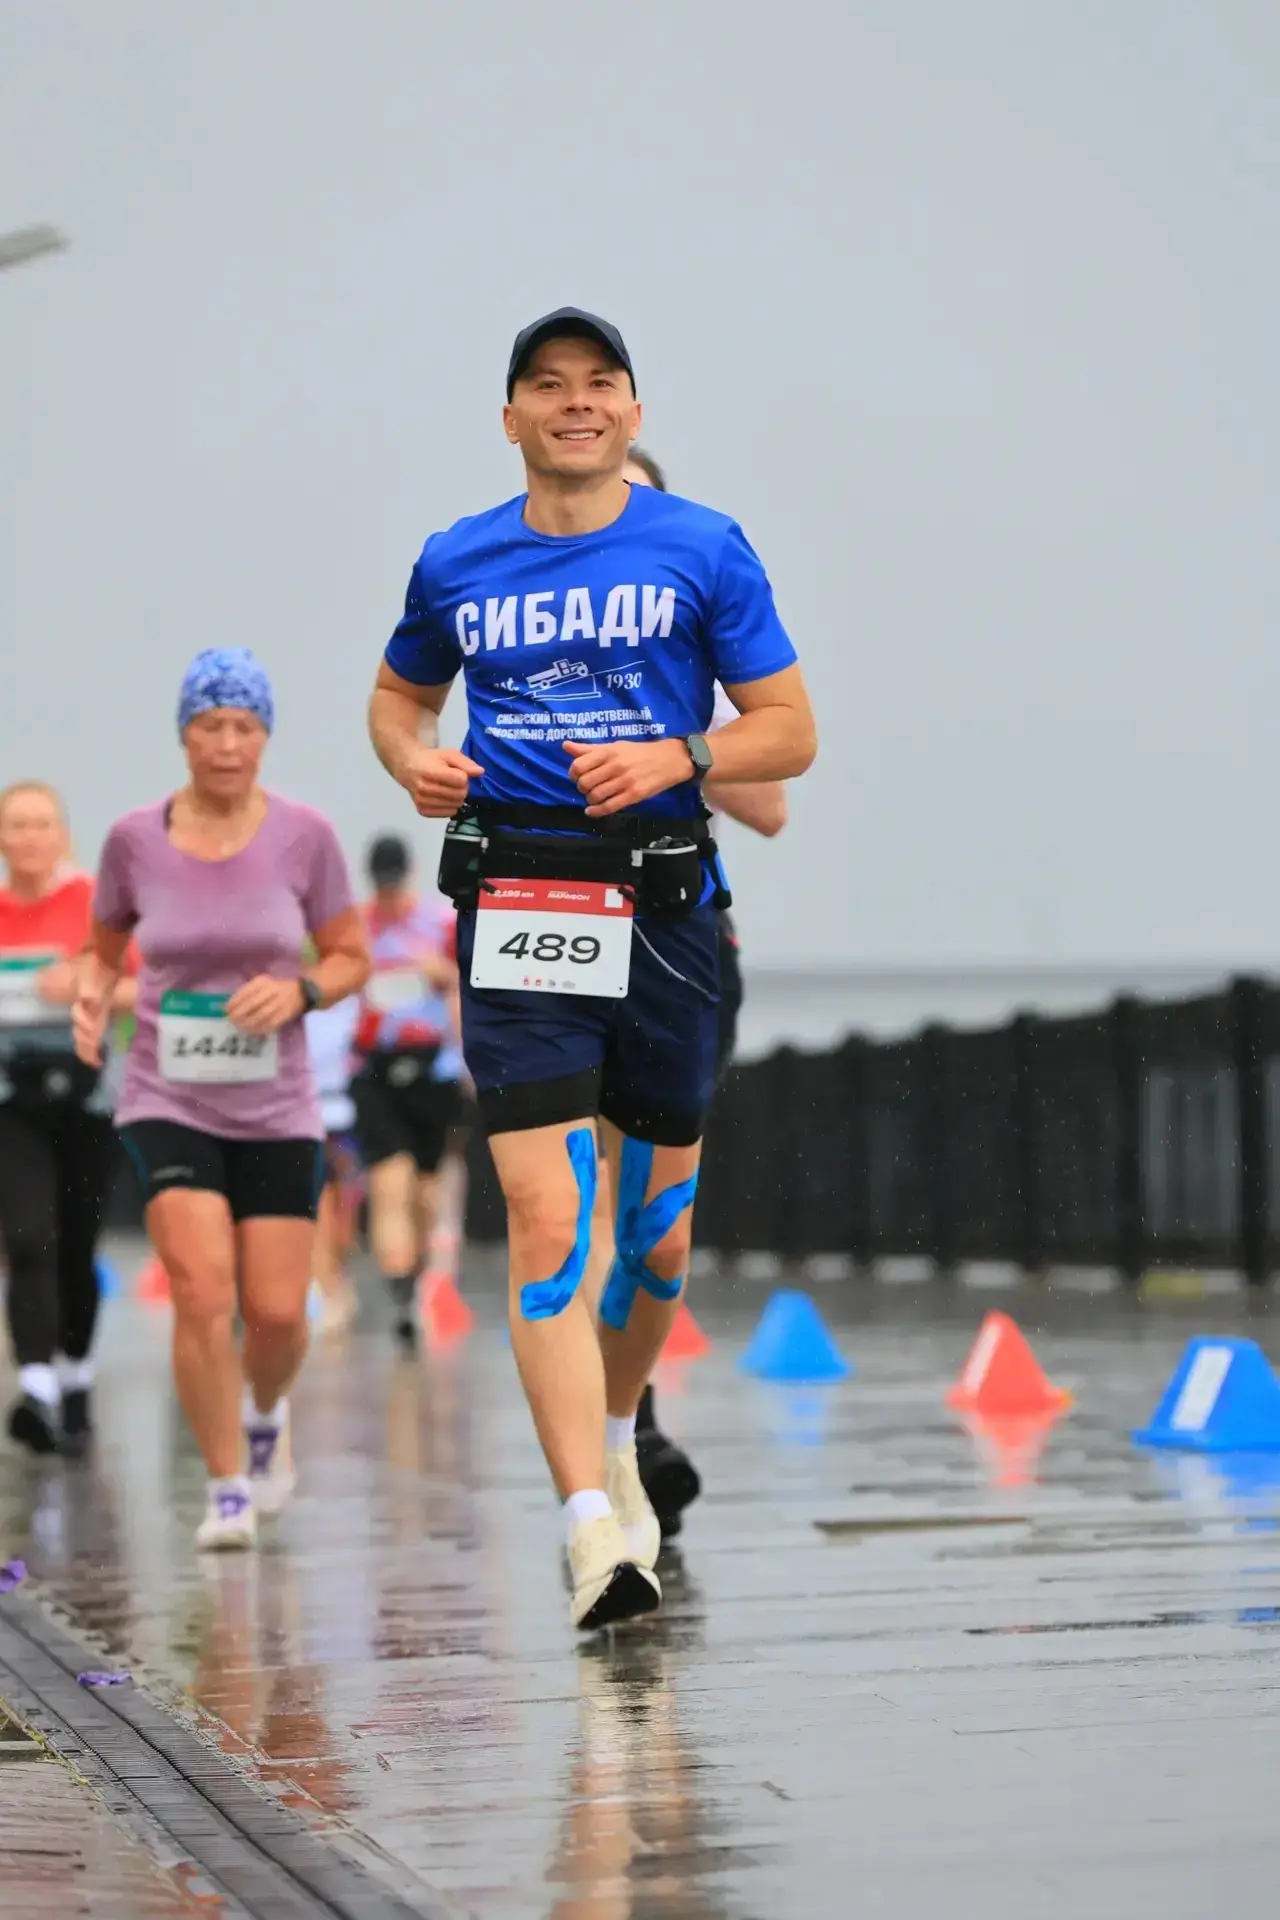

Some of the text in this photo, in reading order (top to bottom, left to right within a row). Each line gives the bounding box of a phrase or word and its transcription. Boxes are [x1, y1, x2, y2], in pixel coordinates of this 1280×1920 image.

[455, 584, 676, 656] СИБАДИ
[605, 671, 643, 690] 1930
[496, 705, 652, 725] СИБИРСКИЙ ГОСУДАРСТВЕННЫЙ
[499, 932, 601, 964] 489
